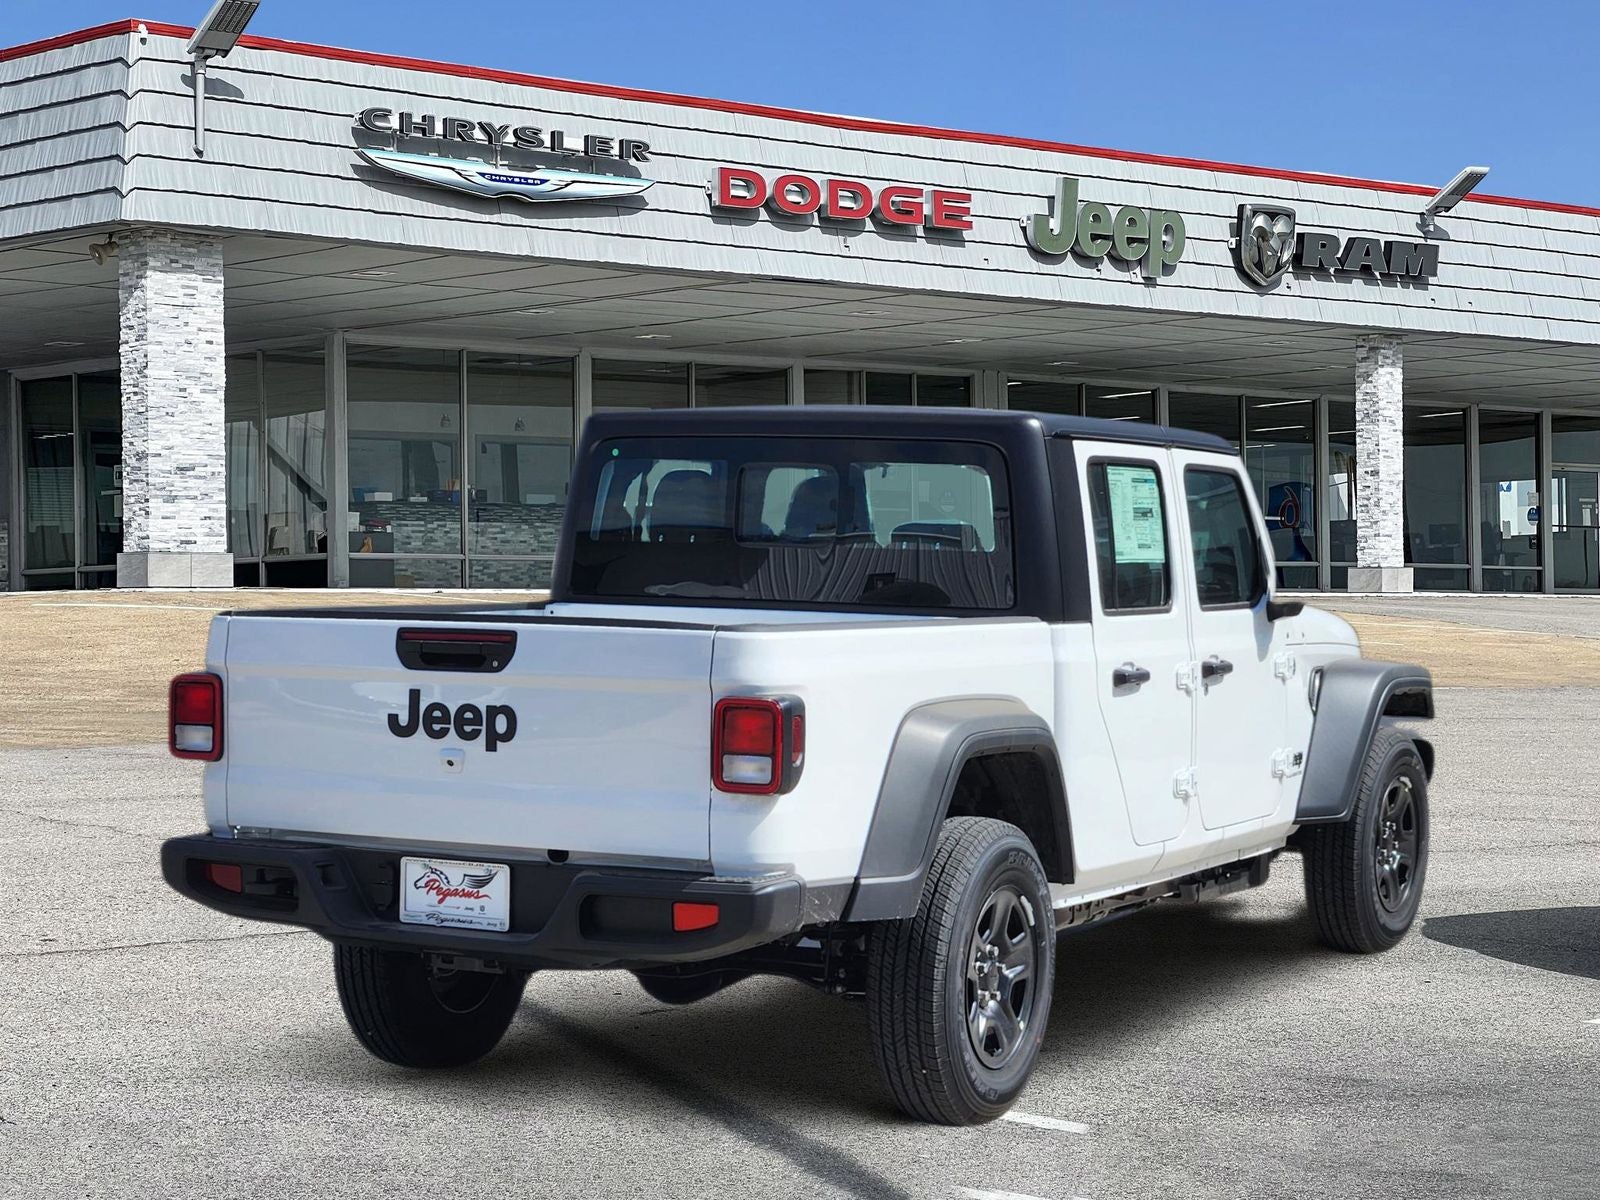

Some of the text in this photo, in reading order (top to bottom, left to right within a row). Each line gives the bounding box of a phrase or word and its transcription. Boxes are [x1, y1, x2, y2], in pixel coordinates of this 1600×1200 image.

[357, 106, 651, 162] CHRYSLER
[484, 174, 541, 184] CHRYSLER
[711, 167, 973, 231] DODGE
[1026, 177, 1186, 278] Jeep
[1297, 232, 1440, 277] RAM
[387, 688, 518, 752] Jeep
[424, 878, 492, 904] Pegasus
